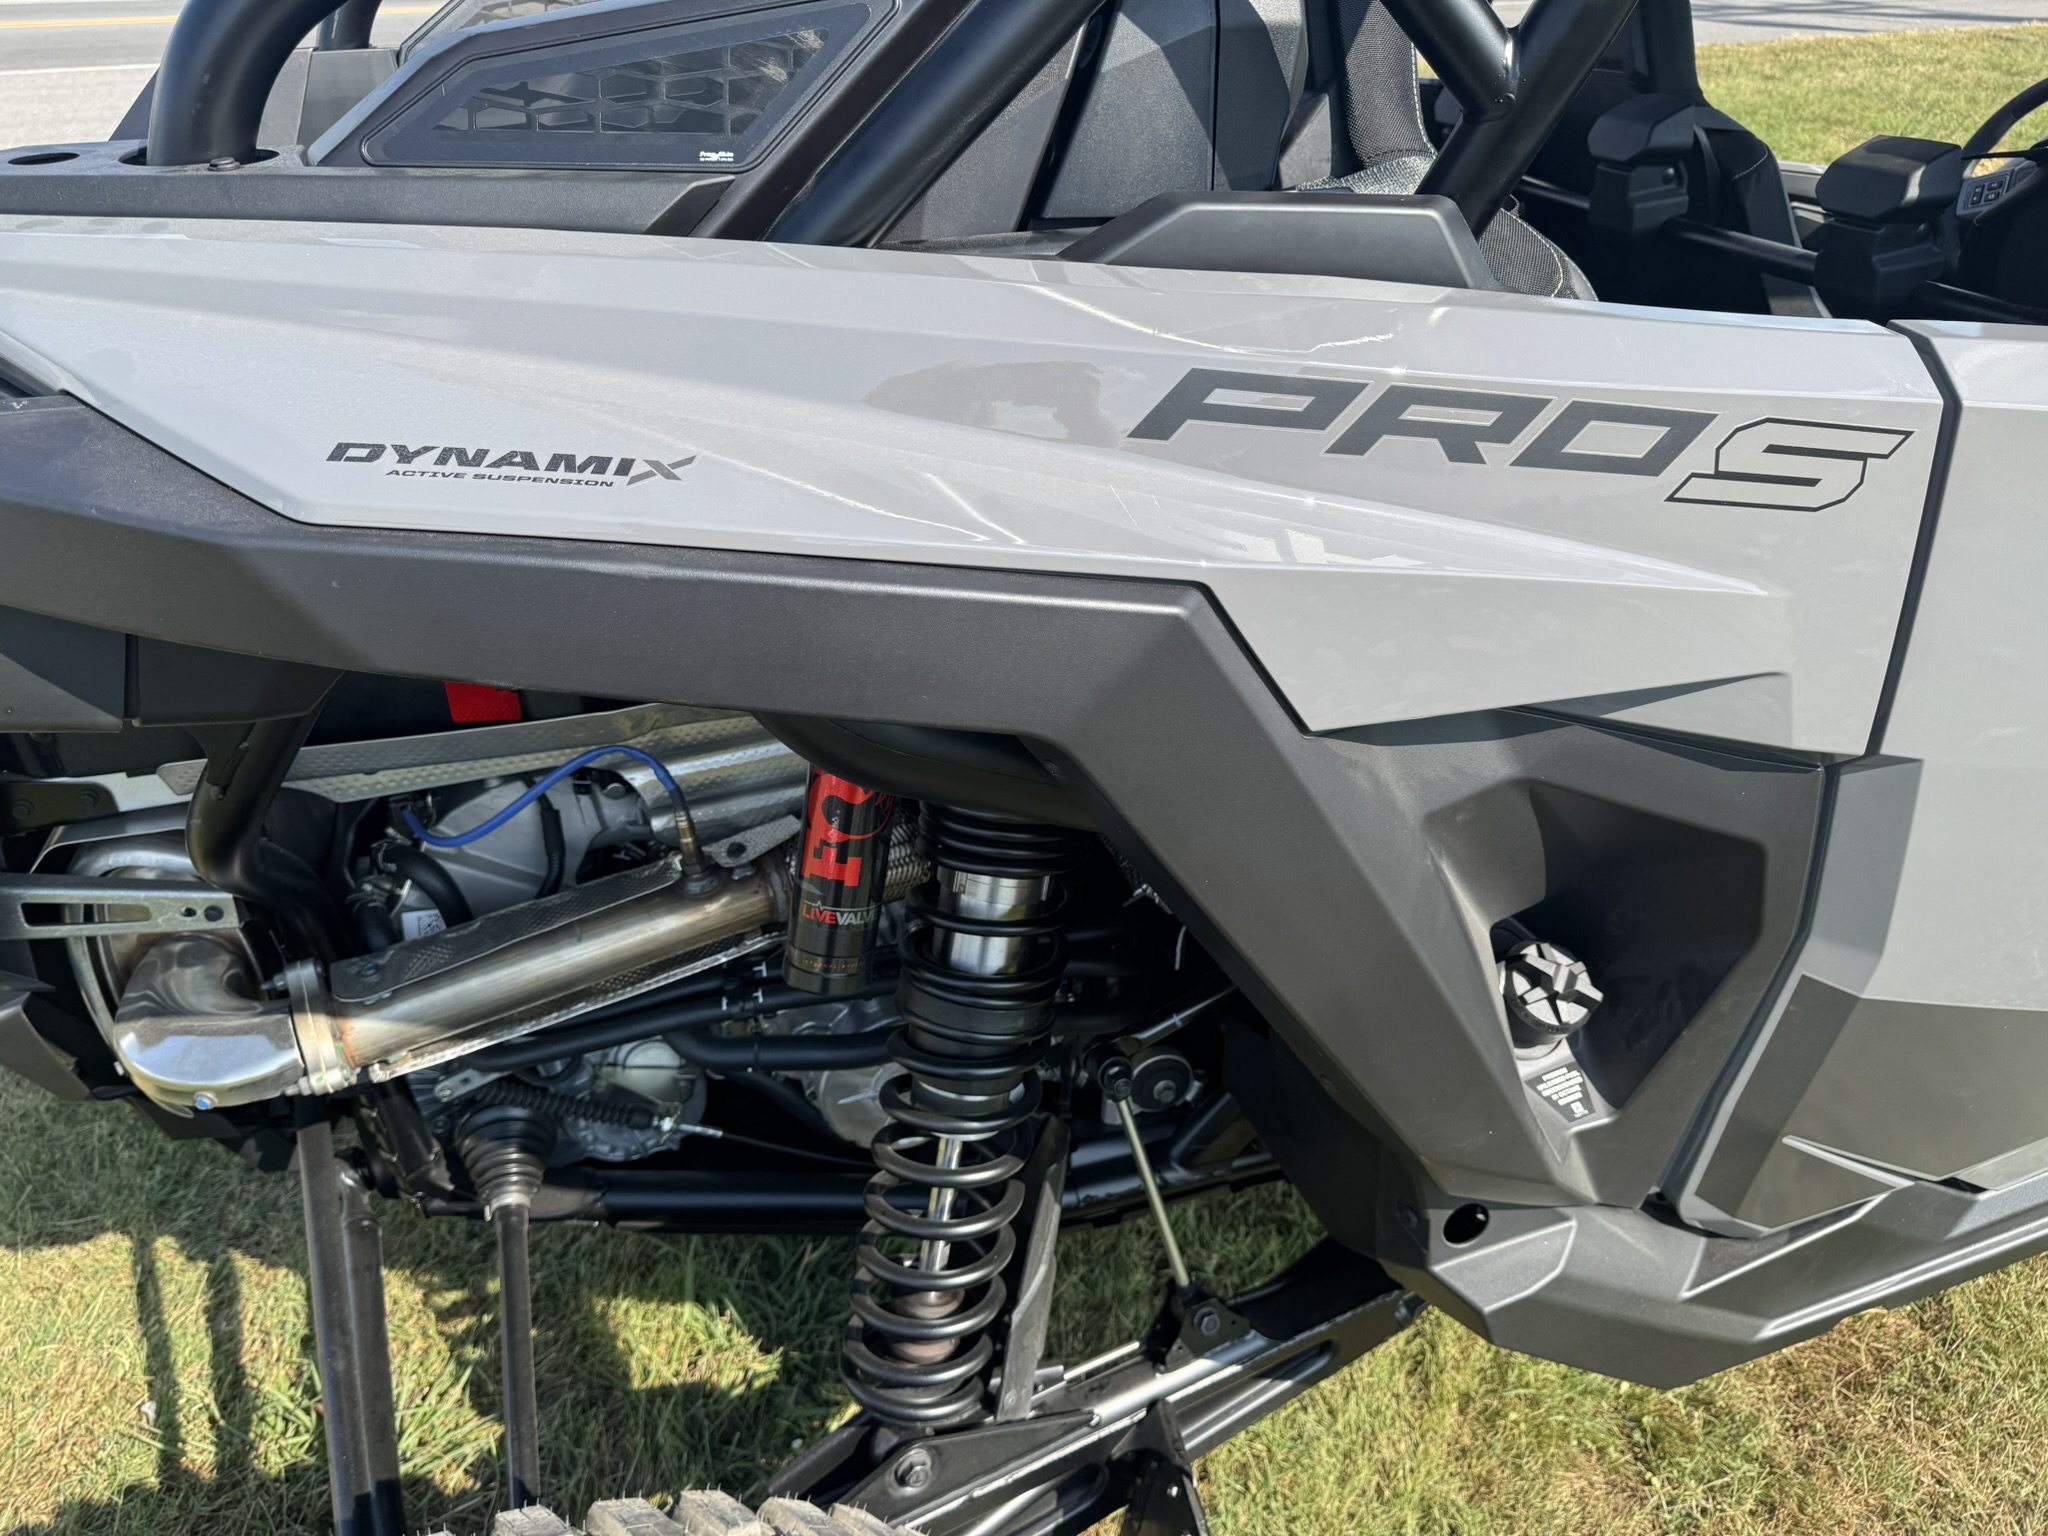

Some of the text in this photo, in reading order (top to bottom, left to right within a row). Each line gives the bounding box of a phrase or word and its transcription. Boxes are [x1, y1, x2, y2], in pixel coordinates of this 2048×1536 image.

[326, 442, 697, 487] DYNAMIX
[385, 469, 614, 487] ACTIVE SUSPENSION
[1126, 367, 1917, 512] PRO S
[801, 768, 894, 887] FO
